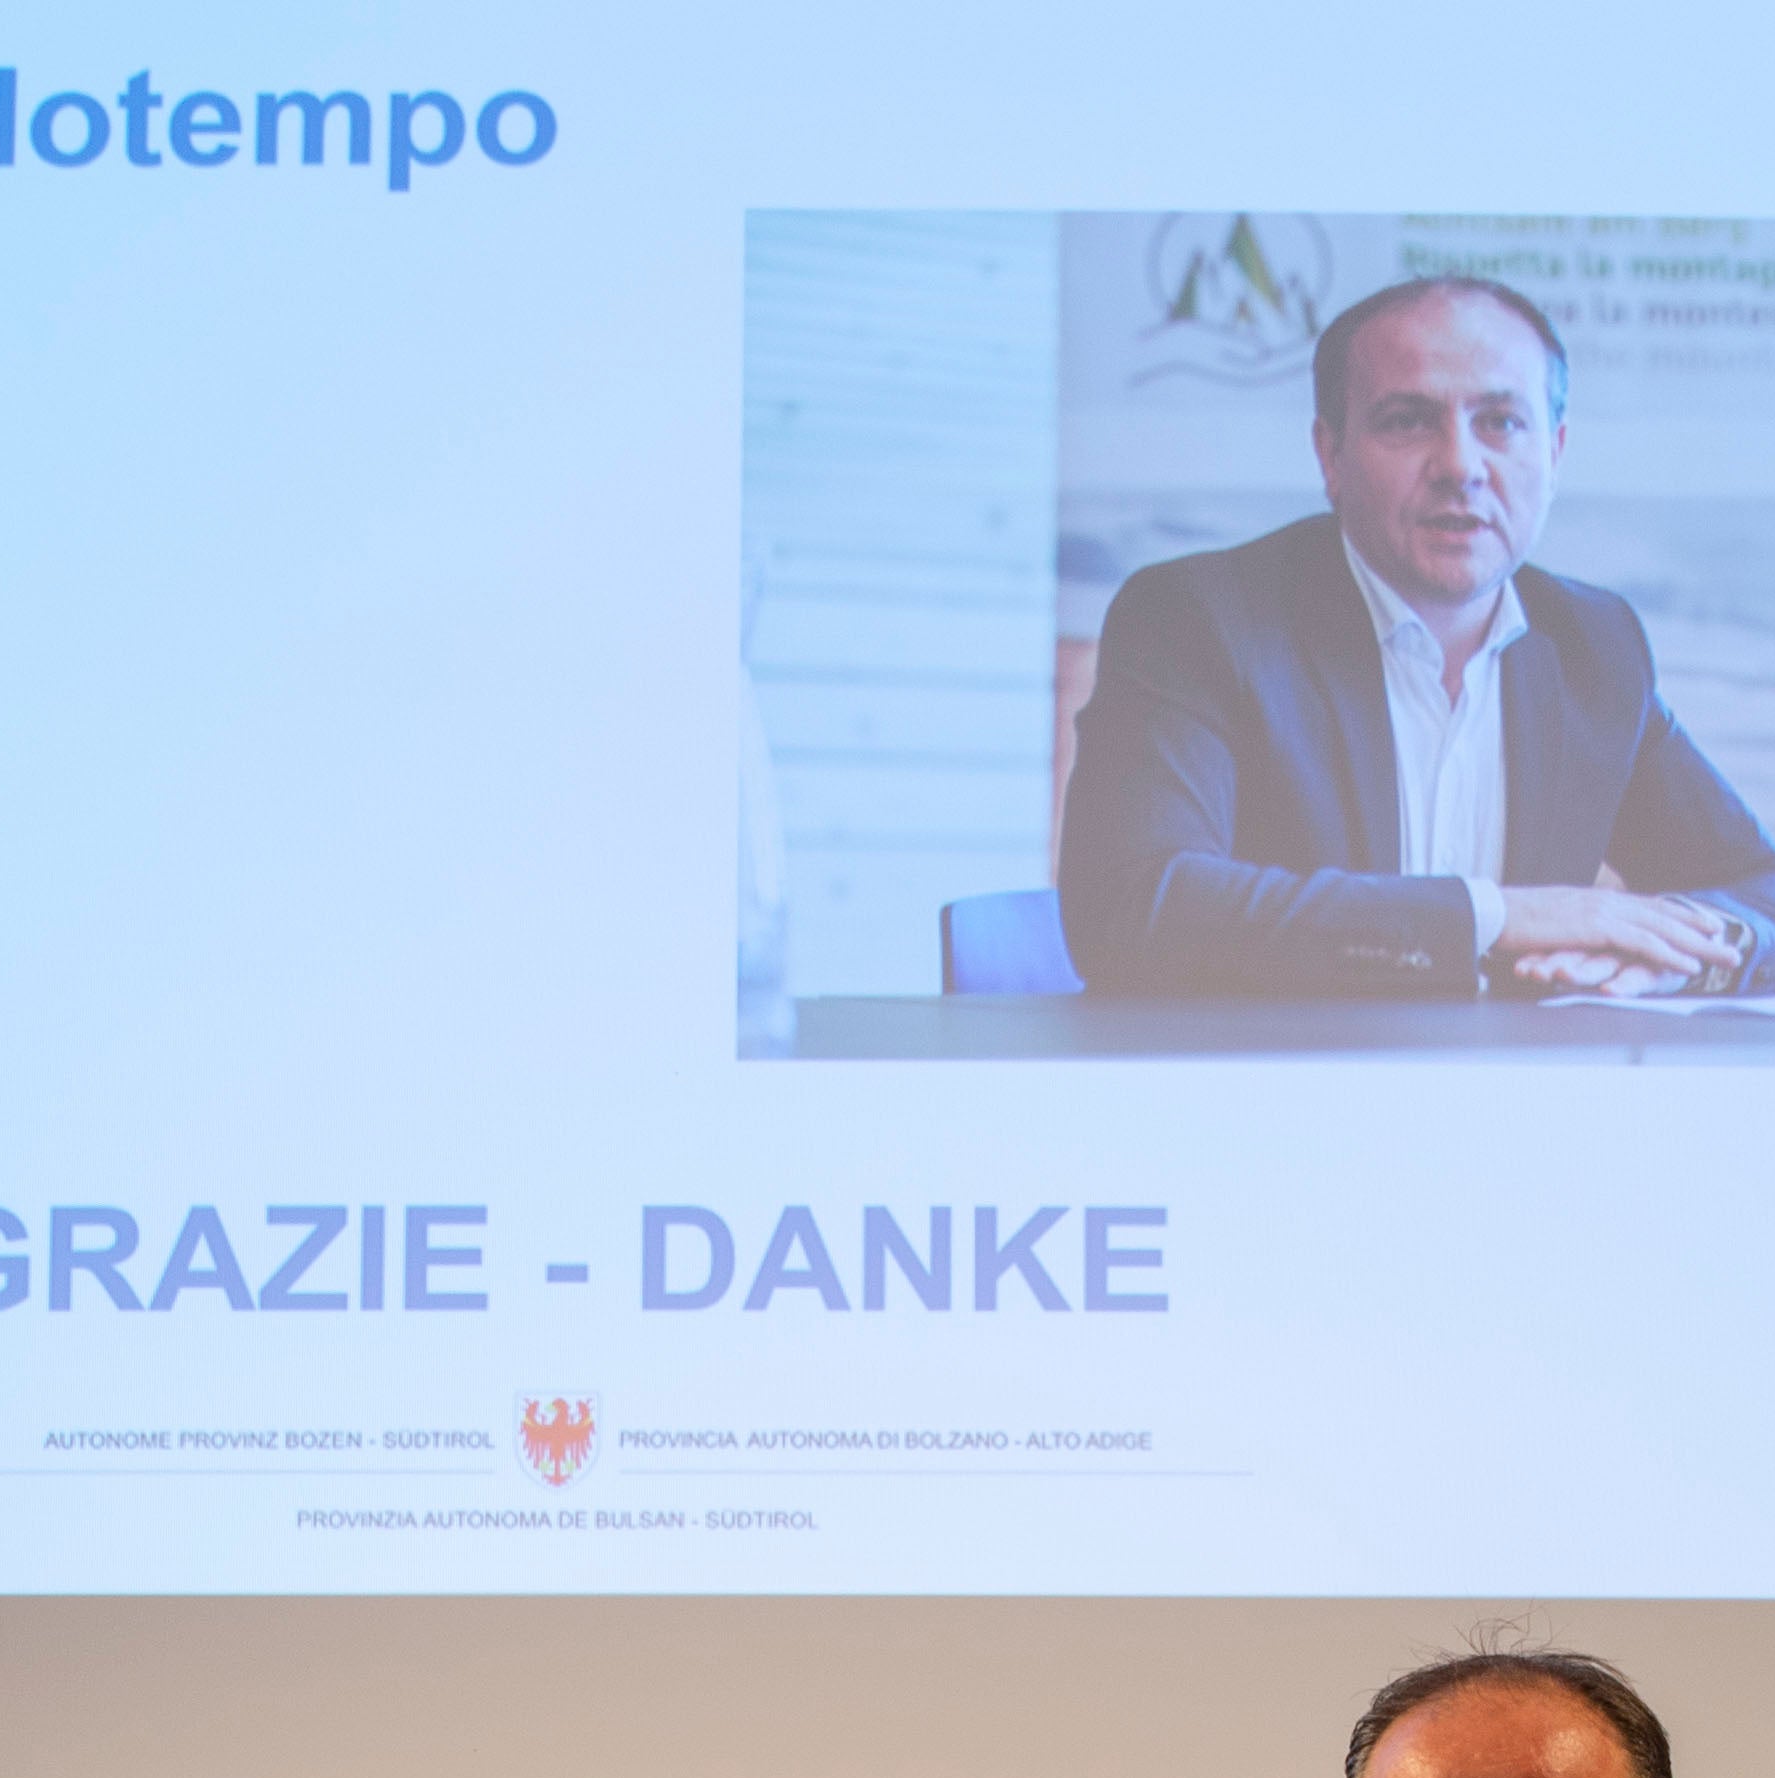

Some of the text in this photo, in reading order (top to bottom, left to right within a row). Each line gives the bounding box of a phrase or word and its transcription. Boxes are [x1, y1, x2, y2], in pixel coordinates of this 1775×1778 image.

[639, 1204, 1170, 1312] DANKE
[43, 1431, 172, 1451] AUTONOME
[180, 1431, 279, 1451] PROVINZ
[285, 1431, 363, 1451] BOZEN
[383, 1428, 497, 1451] SÜDTIROL
[619, 1430, 738, 1450] PROVINCIA
[747, 1430, 872, 1450] AUTONOMA
[877, 1430, 900, 1450] DI
[905, 1430, 1008, 1450] BOLZANO
[1026, 1430, 1081, 1450] ALTO
[1085, 1430, 1153, 1450] ADIGE
[297, 1510, 417, 1530] PROVINZIA
[424, 1510, 552, 1530] AUTONOMA
[557, 1510, 589, 1530] DE
[595, 1510, 685, 1530] BULSAN
[705, 1508, 819, 1530] SÜDTIROL
